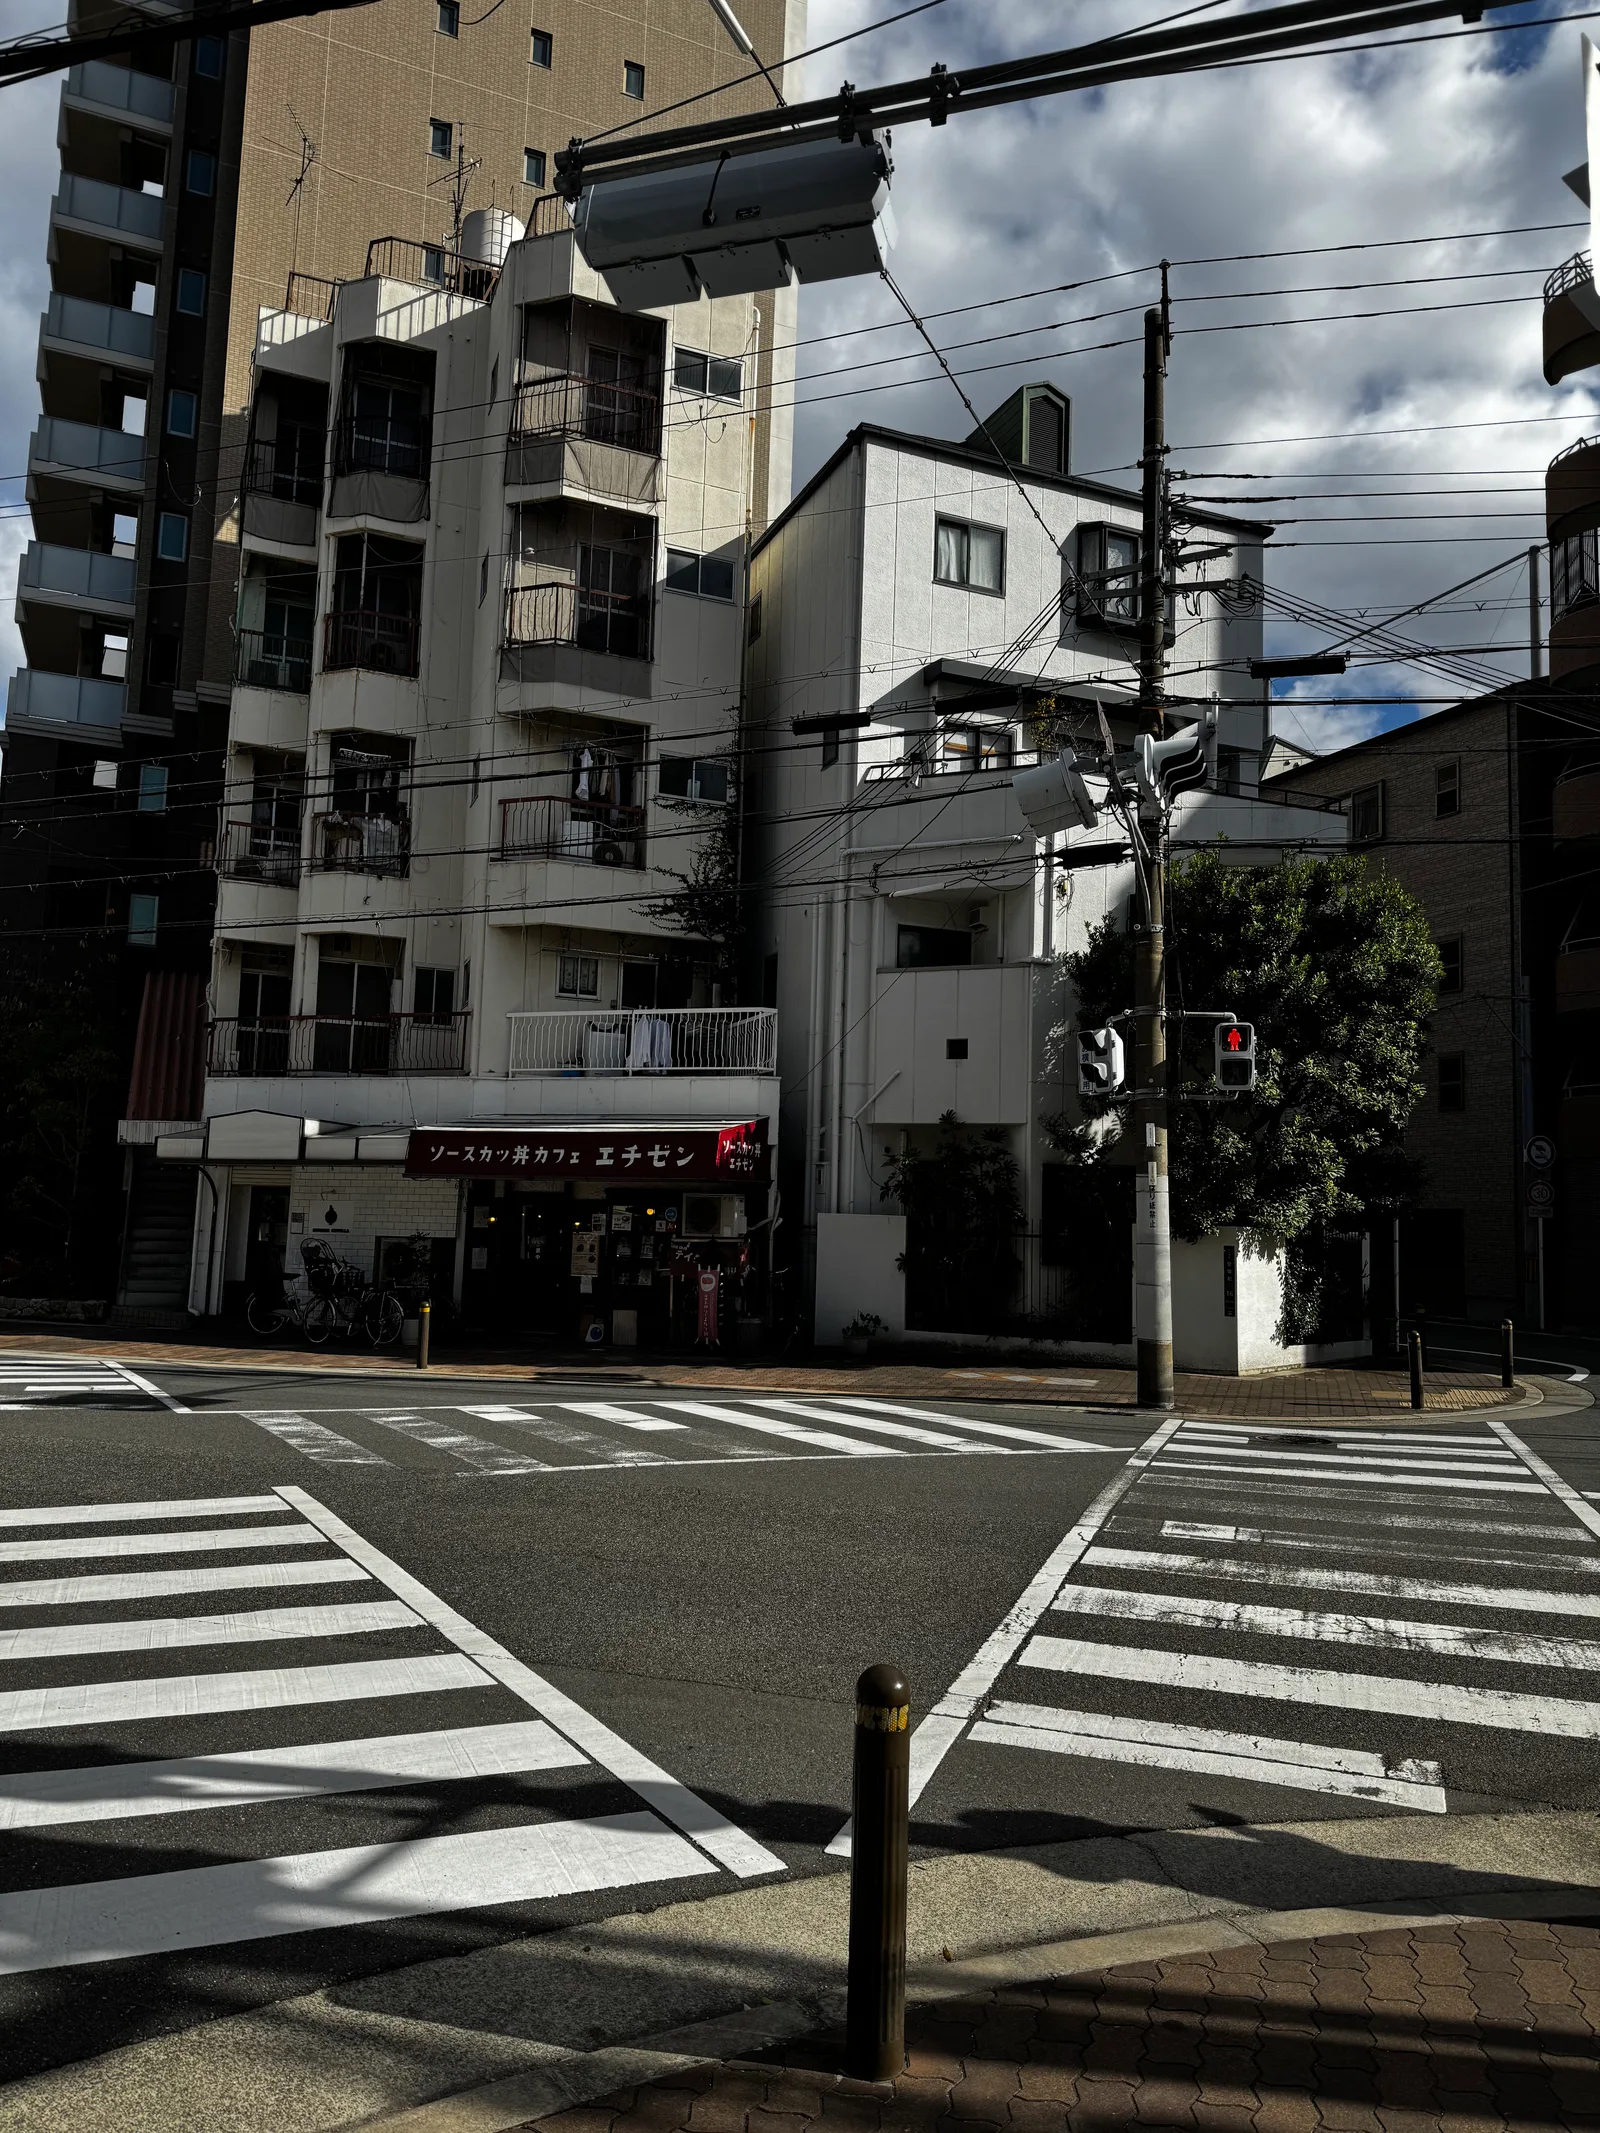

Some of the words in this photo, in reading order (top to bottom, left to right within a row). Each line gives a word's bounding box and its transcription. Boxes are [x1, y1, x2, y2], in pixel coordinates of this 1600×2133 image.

[430, 1144, 580, 1165] ソースカツ丼カフェ
[595, 1143, 695, 1168] エチゼン
[722, 1139, 762, 1158] ソースカツ丼
[729, 1157, 755, 1171] エチゼン
[1533, 1188, 1548, 1199] 30
